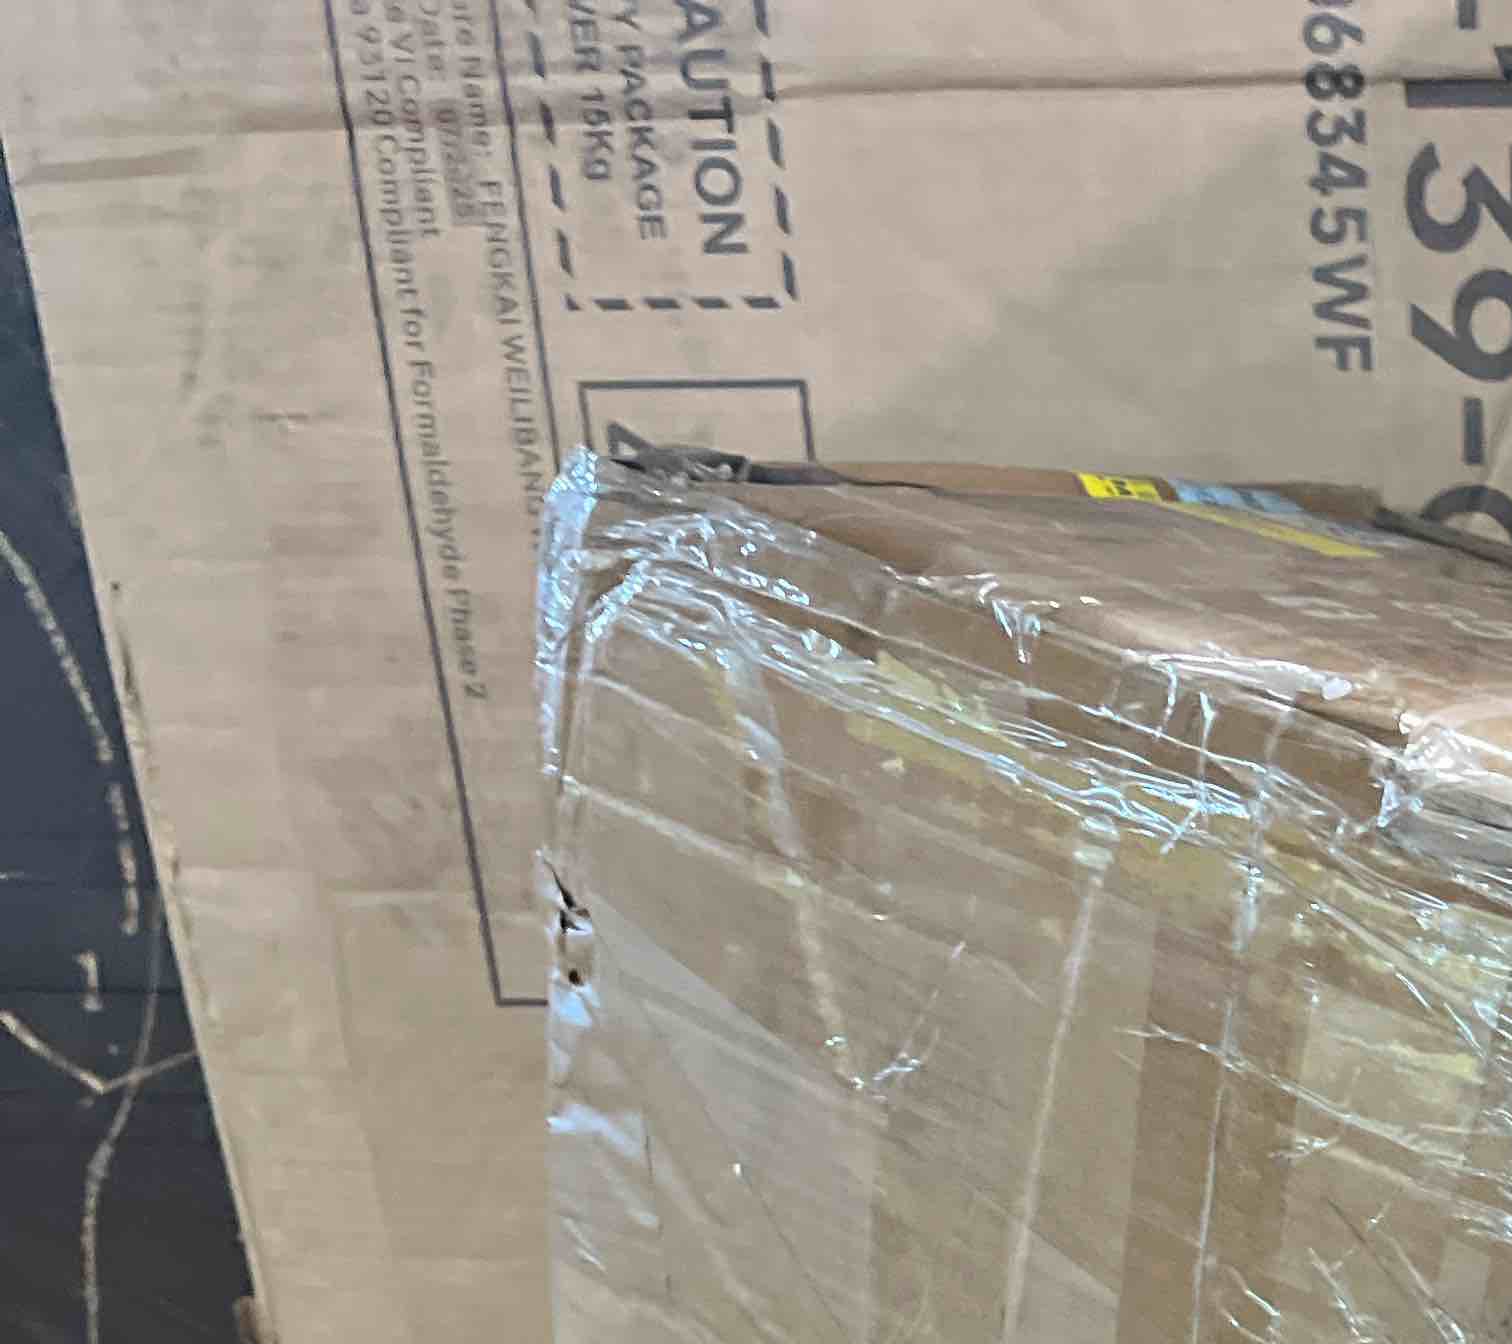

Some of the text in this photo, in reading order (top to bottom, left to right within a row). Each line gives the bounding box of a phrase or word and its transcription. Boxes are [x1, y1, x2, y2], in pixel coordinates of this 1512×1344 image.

[356, 25, 396, 127] 93120
[400, 73, 441, 238] Compliant
[616, 44, 668, 241] PACKAGE
[376, 133, 418, 296] Compliant
[458, 56, 493, 158] Name:
[478, 180, 521, 324] FENGKAI
[1302, 0, 1374, 373] 68345WF
[400, 308, 426, 352] for
[407, 361, 466, 581] Formaldehyde
[448, 588, 478, 678] Phase
[464, 682, 488, 699] 2
